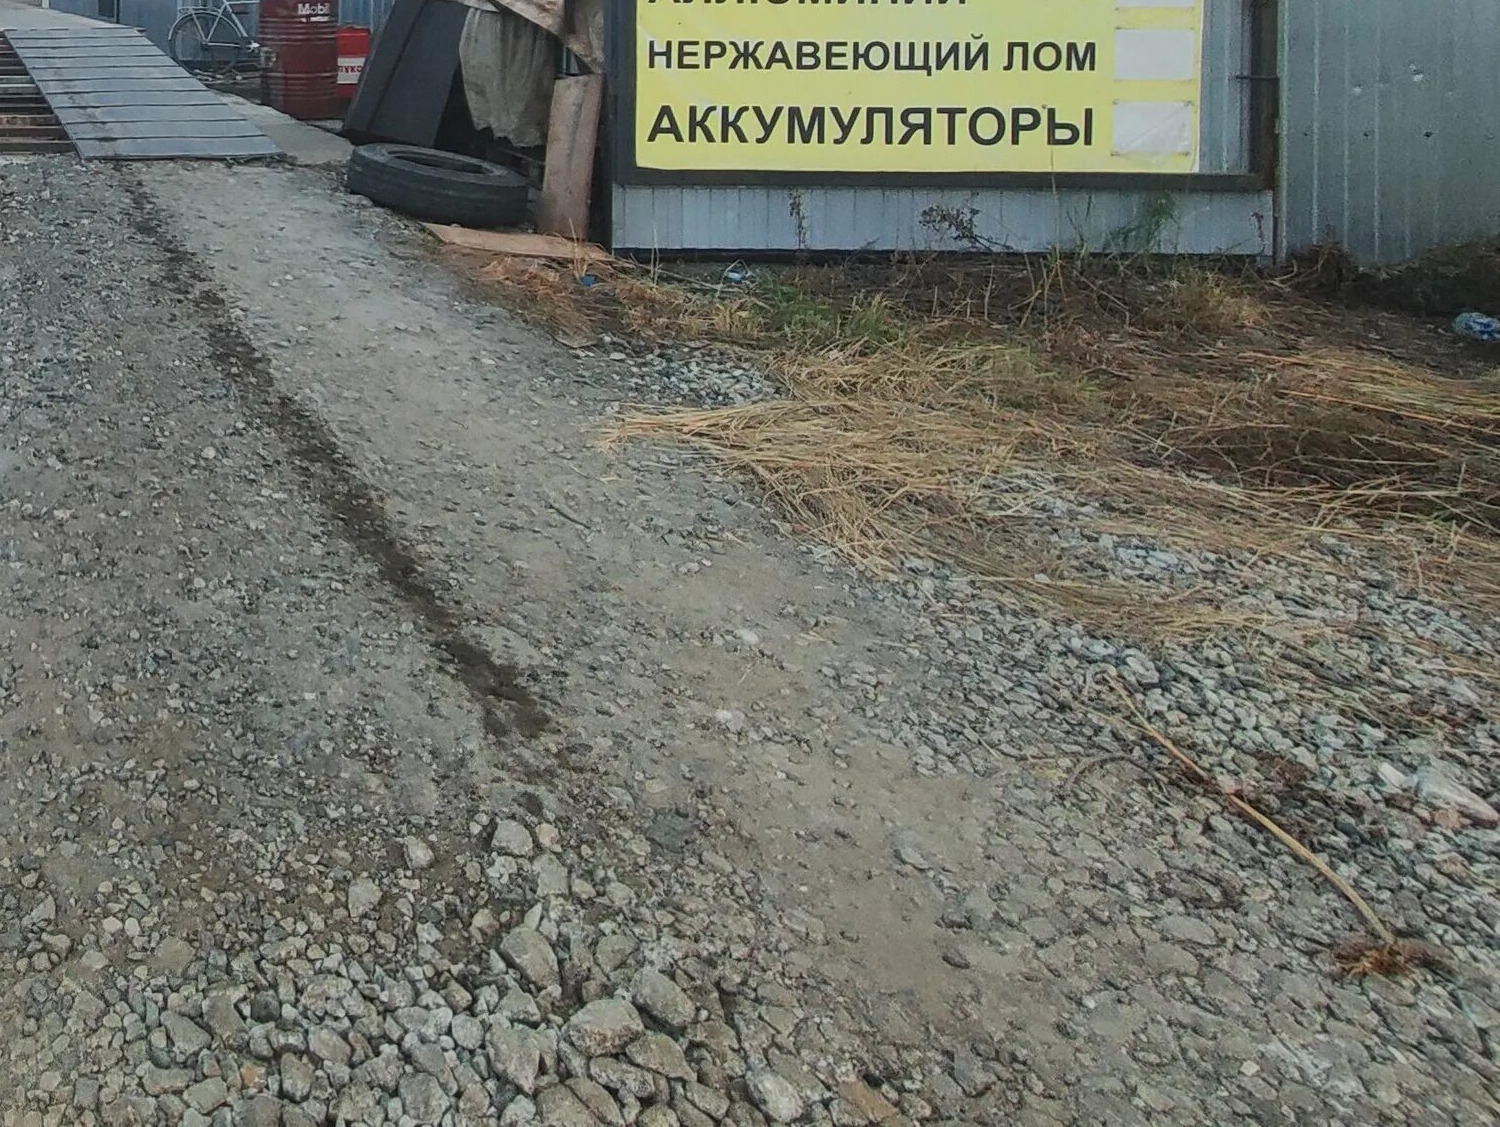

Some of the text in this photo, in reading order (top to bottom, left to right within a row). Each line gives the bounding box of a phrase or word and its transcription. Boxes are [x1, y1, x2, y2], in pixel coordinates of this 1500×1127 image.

[648, 34, 1097, 77] НЕРЖАВЕЮЩИЙ ЛОМ
[647, 106, 1094, 147] АККУМУЛЯТОРЫ
